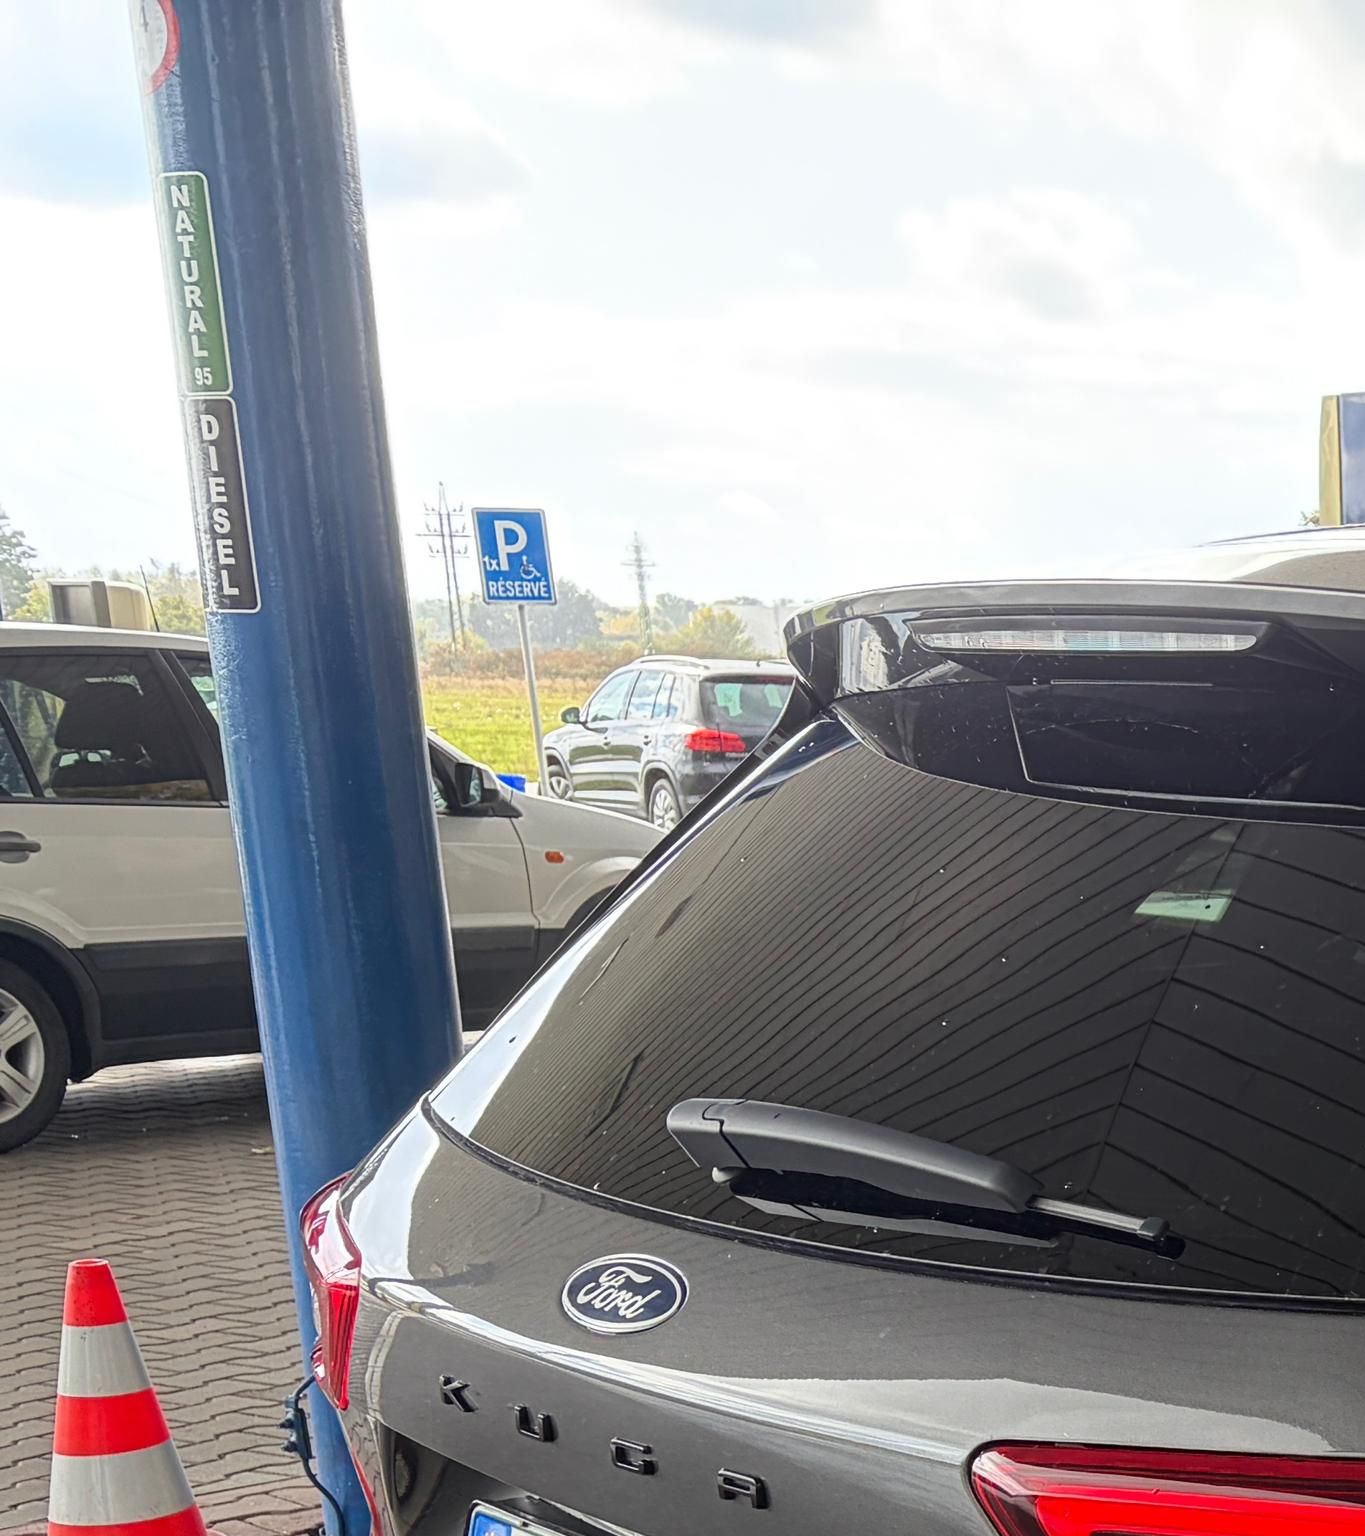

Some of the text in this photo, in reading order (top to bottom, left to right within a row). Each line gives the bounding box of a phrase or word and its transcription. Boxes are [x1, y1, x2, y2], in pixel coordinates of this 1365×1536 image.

[170, 184, 213, 386] NATURAL 95
[200, 414, 240, 595] DIESEL
[493, 519, 528, 571] P
[576, 1265, 662, 1319] Ford
[439, 1374, 773, 1510] KUGA
